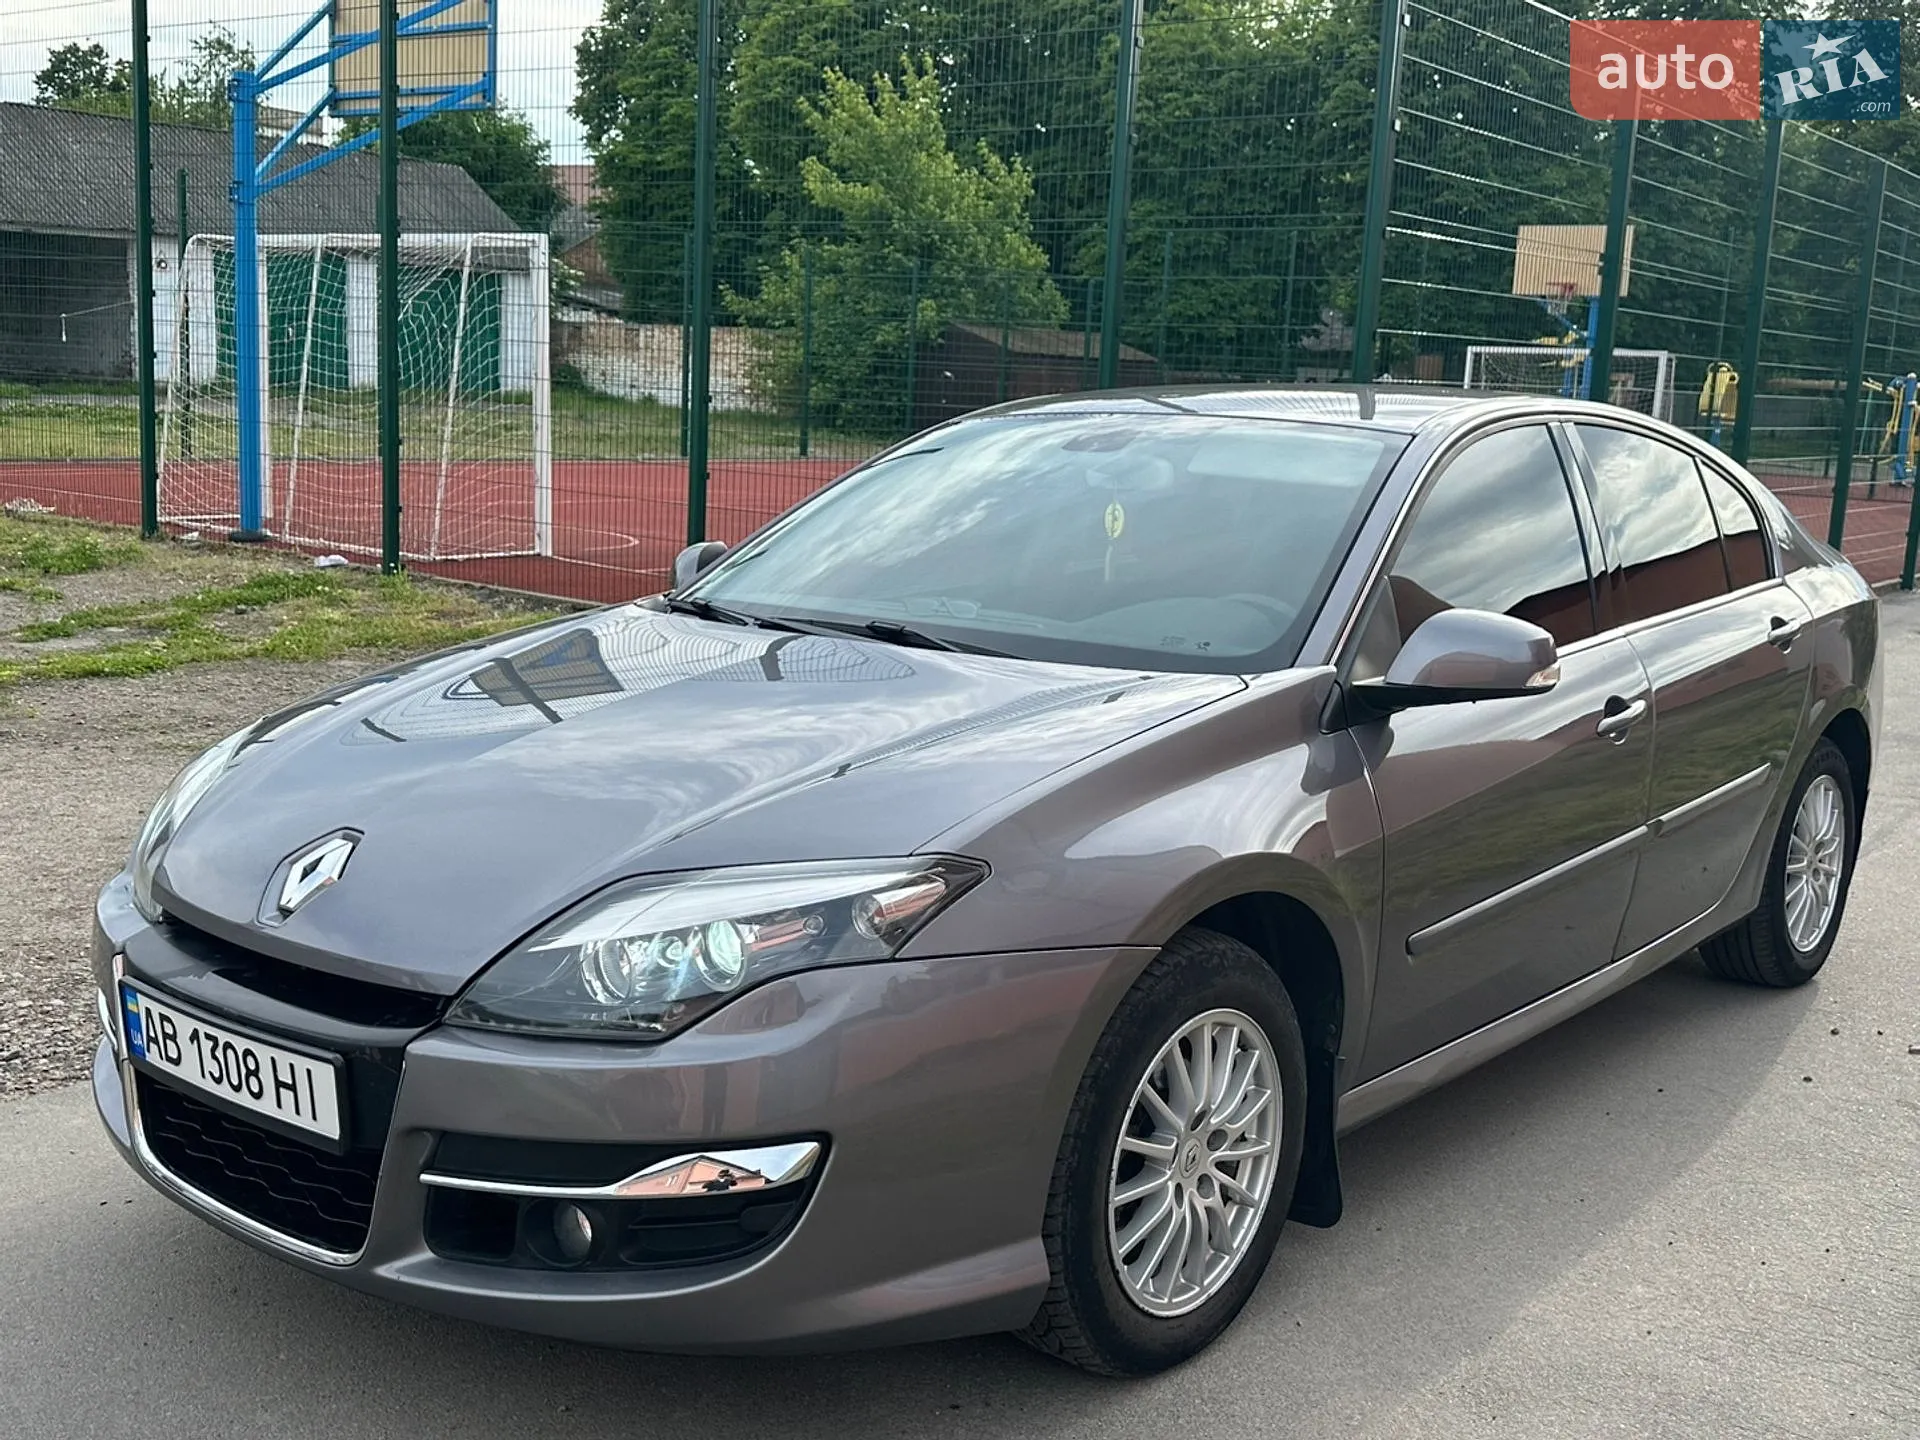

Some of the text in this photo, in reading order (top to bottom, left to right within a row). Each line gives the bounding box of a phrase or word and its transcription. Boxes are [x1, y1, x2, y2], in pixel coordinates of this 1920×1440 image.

[130, 1028, 143, 1047] UA
[145, 1007, 317, 1122] AB 1308 HI
